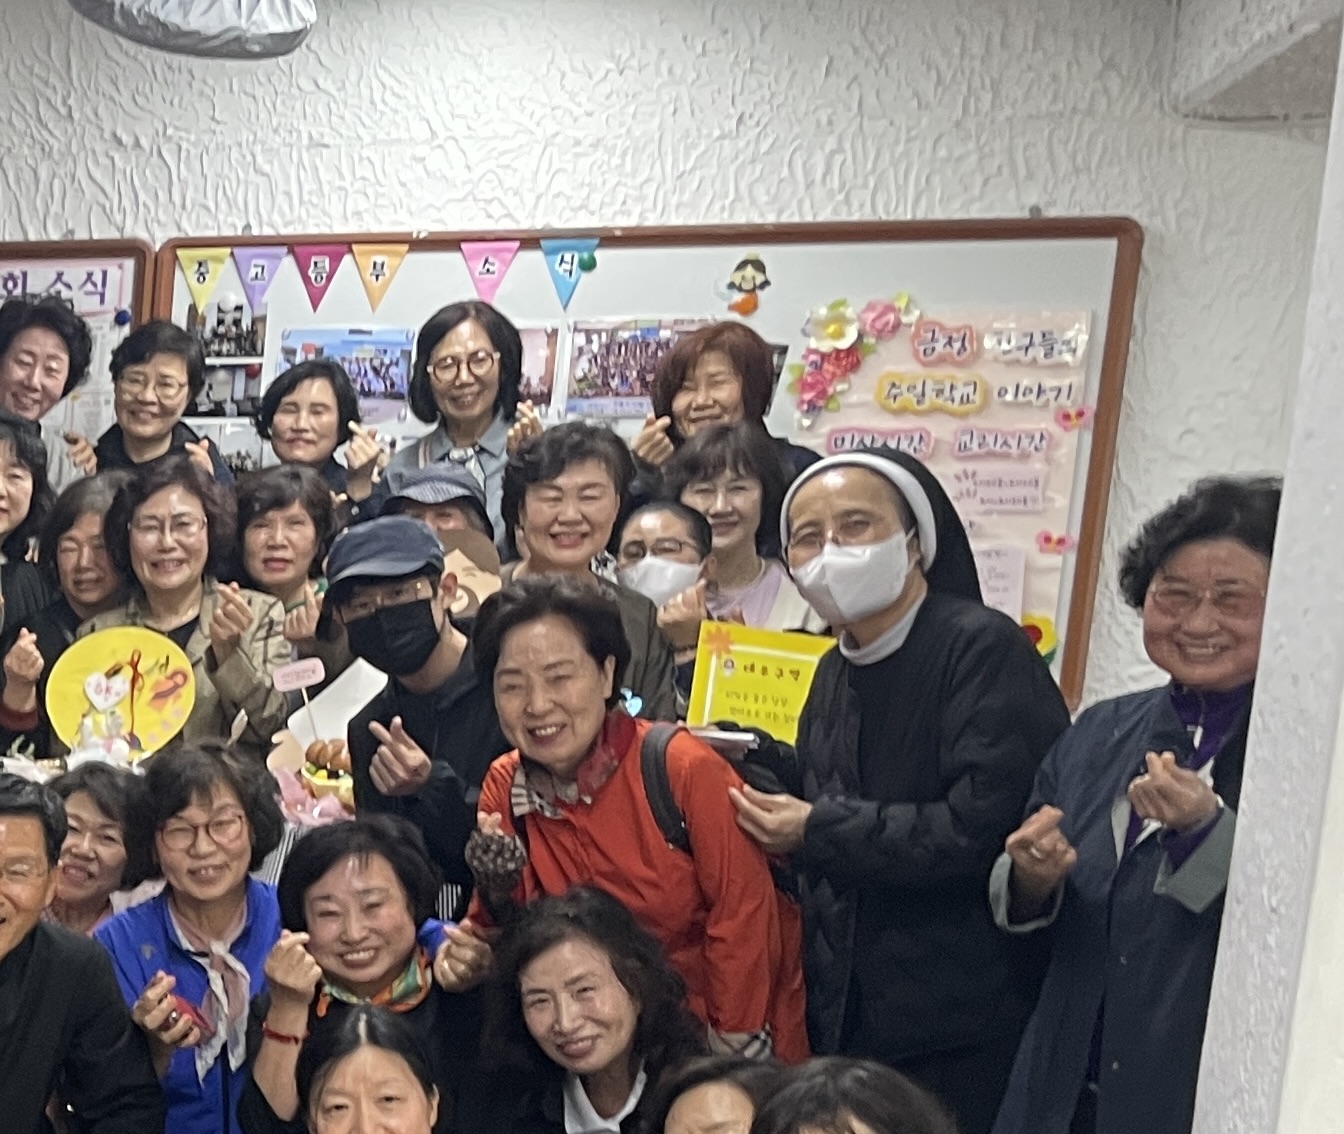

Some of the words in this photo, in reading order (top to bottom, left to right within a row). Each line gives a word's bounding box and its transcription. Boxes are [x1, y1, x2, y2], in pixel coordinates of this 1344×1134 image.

[917, 328, 968, 358] 금정
[885, 379, 978, 407] 주일학교
[996, 380, 1074, 403] 이야기
[958, 429, 1047, 453] 교리시간
